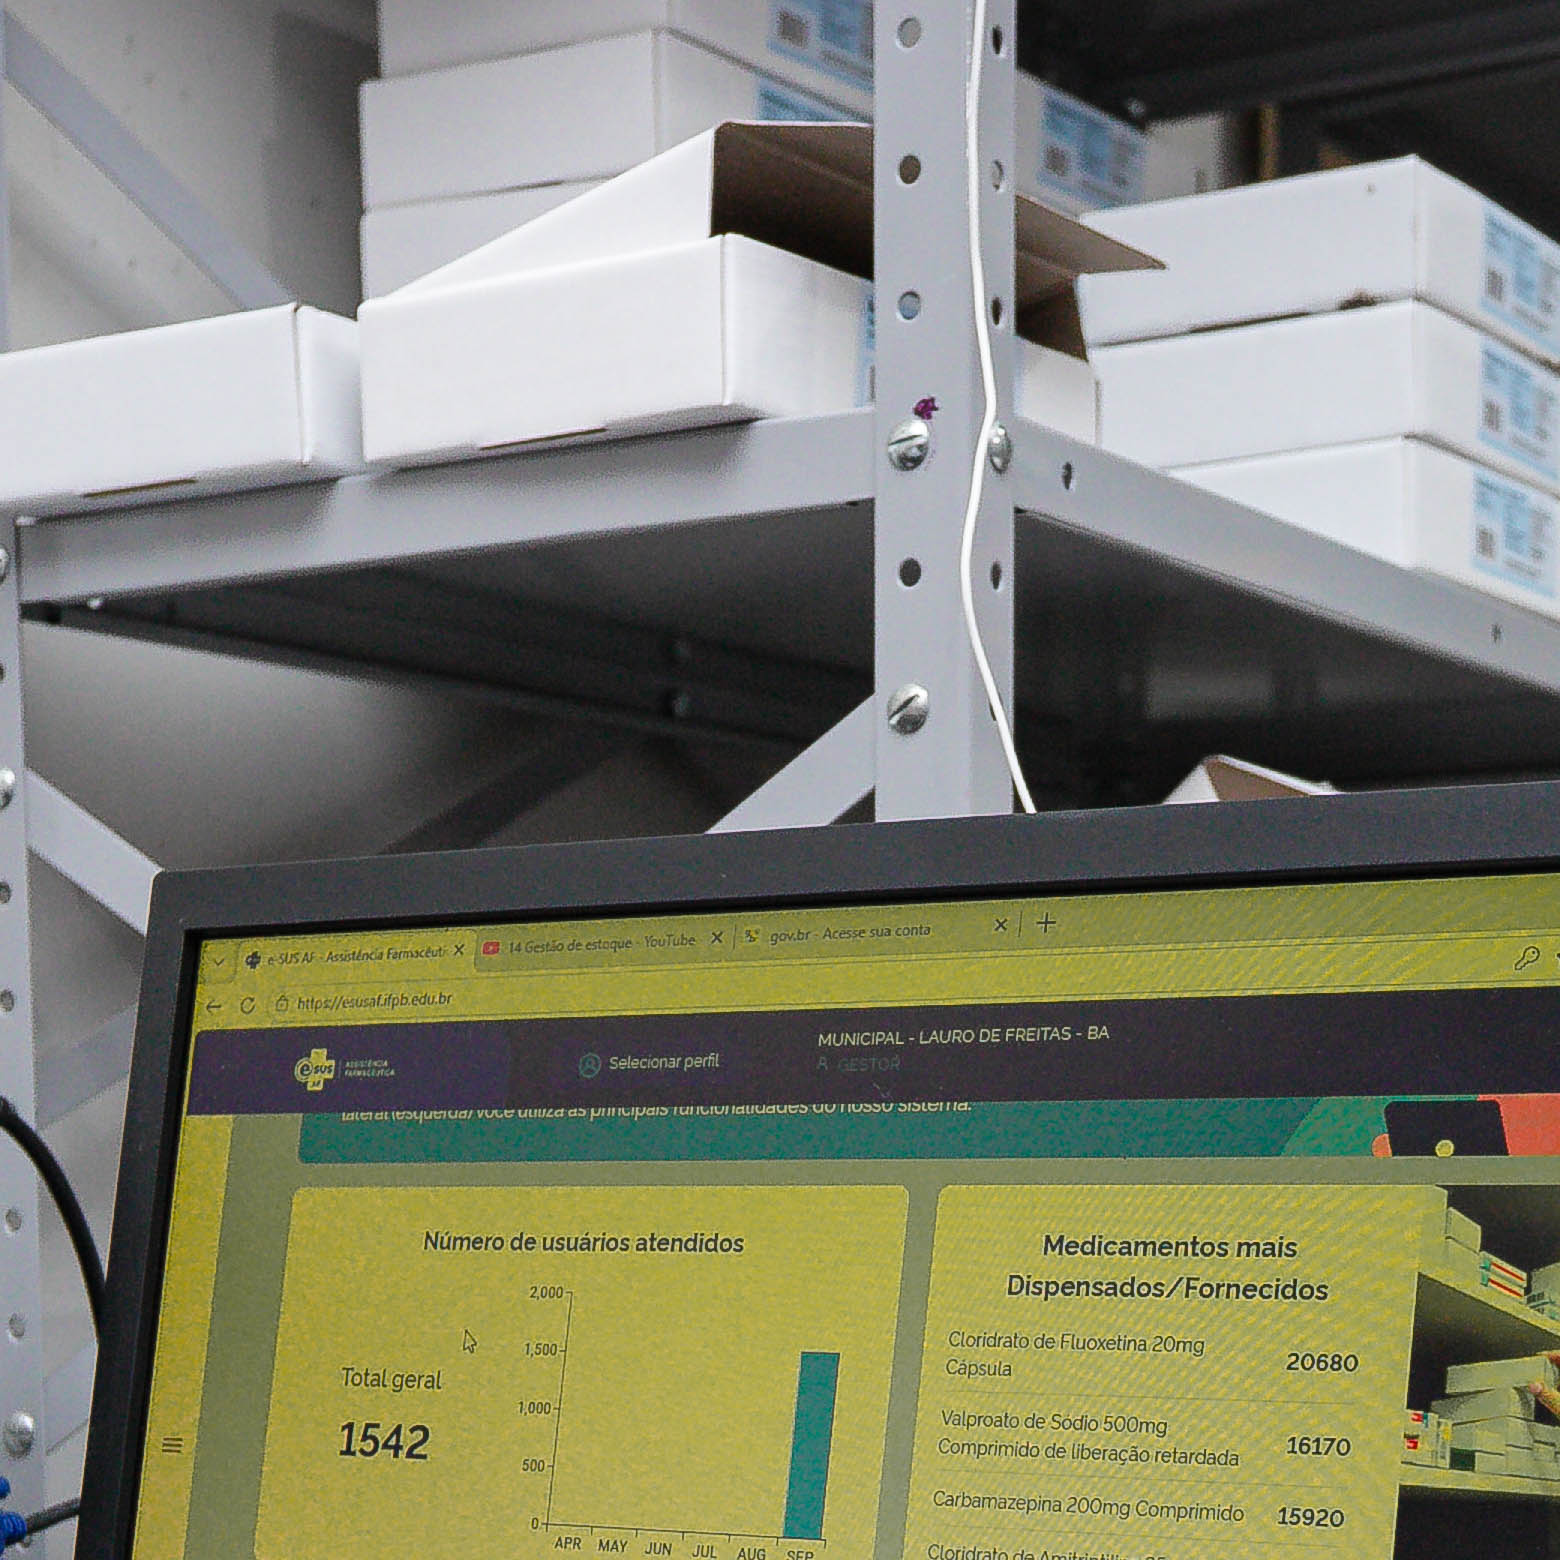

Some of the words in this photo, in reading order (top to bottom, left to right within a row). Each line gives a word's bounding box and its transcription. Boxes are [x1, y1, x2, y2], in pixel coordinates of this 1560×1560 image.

[509, 941, 522, 954] 14
[525, 940, 564, 954] Gestão
[567, 938, 583, 952] de
[585, 938, 633, 954] estoque
[644, 933, 696, 949] YouTube
[770, 928, 811, 945] gov.br
[822, 925, 865, 941] Acesse
[868, 927, 892, 939] sua
[894, 922, 931, 938] conta
[818, 1031, 905, 1048] MUNICIPAL
[919, 1029, 975, 1045] LAURO
[979, 1028, 1002, 1044] DE
[1005, 1026, 1072, 1043] FREITAS
[1088, 1025, 1110, 1041] BA
[609, 1053, 679, 1071] Selecionar
[683, 1052, 720, 1073] perfil
[424, 1231, 505, 1251] Número
[509, 1231, 537, 1251] de
[542, 1232, 630, 1253] usuários
[636, 1233, 745, 1254] atendidos
[1043, 1235, 1232, 1259] Medicamentos
[1236, 1237, 1298, 1259] mais
[530, 1285, 565, 1302] 2,000
[1006, 1275, 1329, 1302] Dispensados/Fornecidos
[524, 1342, 558, 1359] 1,500
[948, 1331, 1030, 1351] Cloridrato
[1034, 1333, 1056, 1351] de
[1060, 1333, 1149, 1354] Fluoxetina
[1151, 1336, 1205, 1357] 20mg
[945, 1358, 1012, 1379] Cápsula
[1286, 1353, 1359, 1373] 20680
[341, 1367, 388, 1389] Total
[392, 1369, 442, 1392] geral
[518, 1401, 552, 1418] 1,000
[941, 1410, 1021, 1432] Valproato
[1025, 1412, 1047, 1430] de
[1050, 1413, 1099, 1432] Sódio
[1103, 1415, 1168, 1438] 500mg
[338, 1423, 431, 1460] 1542
[938, 1437, 1041, 1461] Comprimido
[1044, 1442, 1068, 1459] de
[1071, 1443, 1151, 1466] liberação
[1154, 1447, 1240, 1467] retardada
[1286, 1436, 1352, 1457] 16170
[522, 1458, 545, 1474] 500
[933, 1490, 1062, 1517] Carbamazepina
[1065, 1496, 1132, 1520] 200mg
[1135, 1500, 1245, 1524] Comprimido
[1277, 1507, 1345, 1528] 15920
[530, 1516, 539, 1531] 0
[553, 1536, 582, 1552] APR
[597, 1539, 628, 1555] MAY
[644, 1541, 672, 1557] JUN
[692, 1544, 718, 1560] JUL
